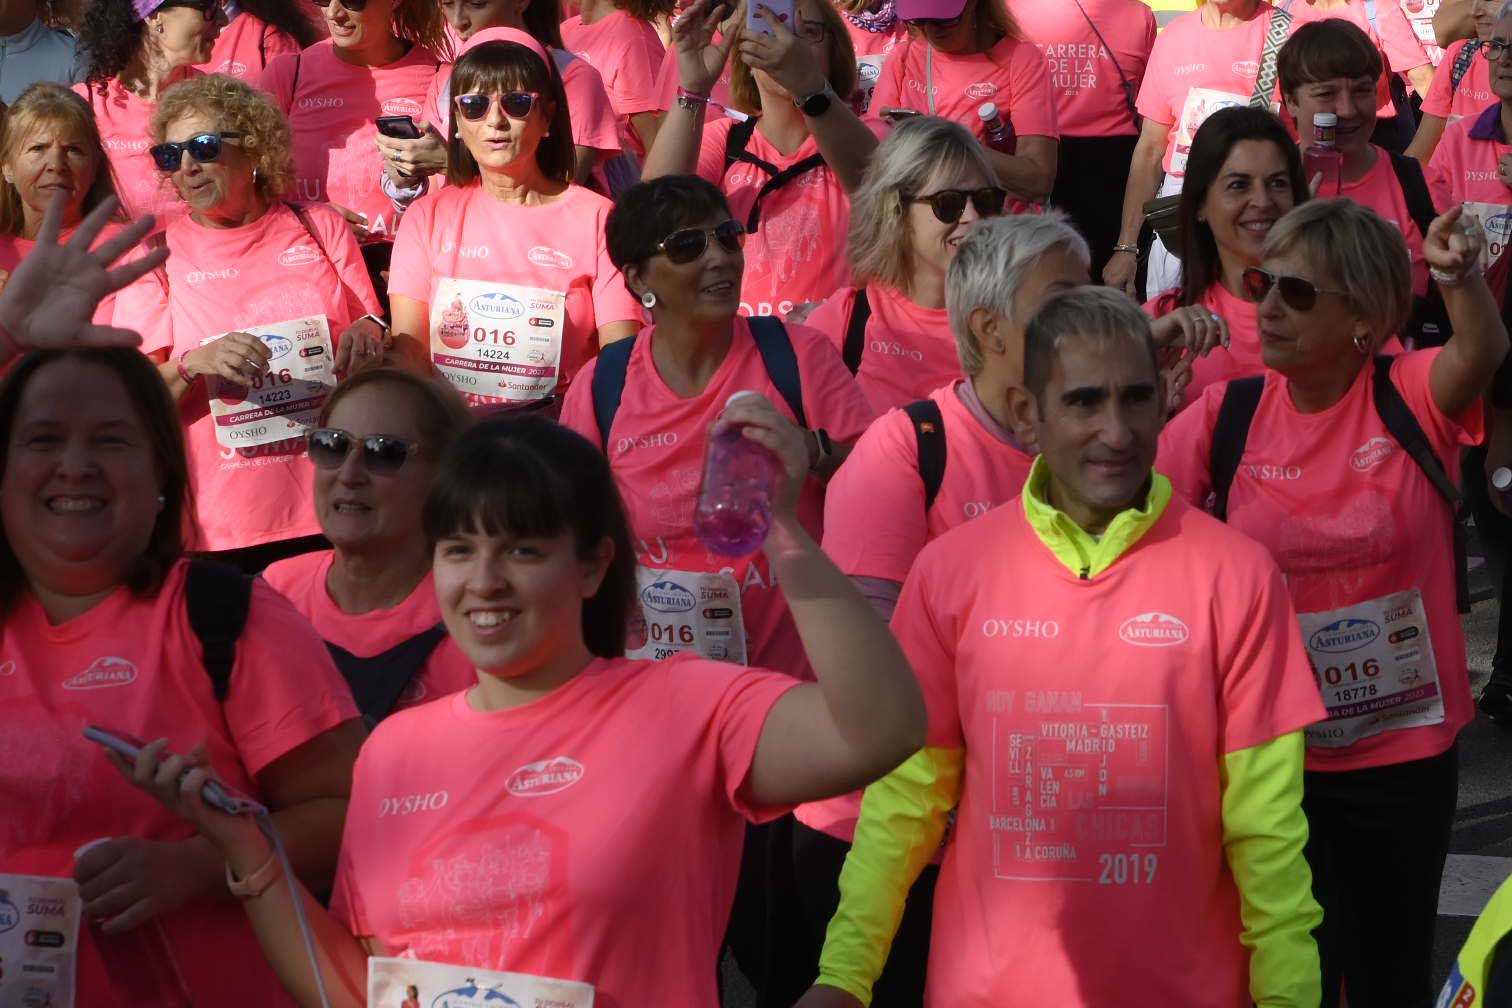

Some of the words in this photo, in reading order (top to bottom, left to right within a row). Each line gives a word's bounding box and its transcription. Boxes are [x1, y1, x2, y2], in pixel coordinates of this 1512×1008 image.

[1036, 44, 1109, 59] ARRERA
[1075, 62, 1095, 73] LA
[298, 98, 344, 109] OYSHO
[186, 268, 240, 283] OYSHO
[474, 301, 521, 315] ASTURIANA
[530, 302, 556, 310] SUMA
[296, 332, 320, 342] SUMA
[473, 327, 516, 346] 016
[477, 349, 510, 360] 14224
[871, 341, 923, 361] OYSHO
[445, 358, 478, 369] CARRERA
[501, 365, 527, 375] MUJER
[251, 368, 292, 389] 016
[442, 372, 477, 385] OYSHO
[508, 381, 548, 391] Santander
[259, 390, 291, 404] 14223
[229, 410, 263, 423] CARRERA
[230, 426, 267, 440] OYSHO
[617, 431, 678, 453] OYSHO
[648, 592, 692, 607] ASTURIANA
[1384, 608, 1413, 624] SUMA
[651, 623, 694, 643] 016
[983, 619, 1059, 639] OYSHO
[1124, 624, 1185, 641] ASTURIANA
[1316, 630, 1376, 648] ASTURIANA
[1324, 658, 1380, 685] 016
[1335, 685, 1377, 702] 18778
[1344, 706, 1356, 716] DE
[1356, 704, 1369, 713] LA
[1370, 697, 1402, 710] MUJER
[1066, 739, 1116, 753] MADRID
[511, 770, 579, 794] ASTURIANA
[989, 816, 1046, 831] BARCELONA
[1099, 853, 1159, 885] 2019
